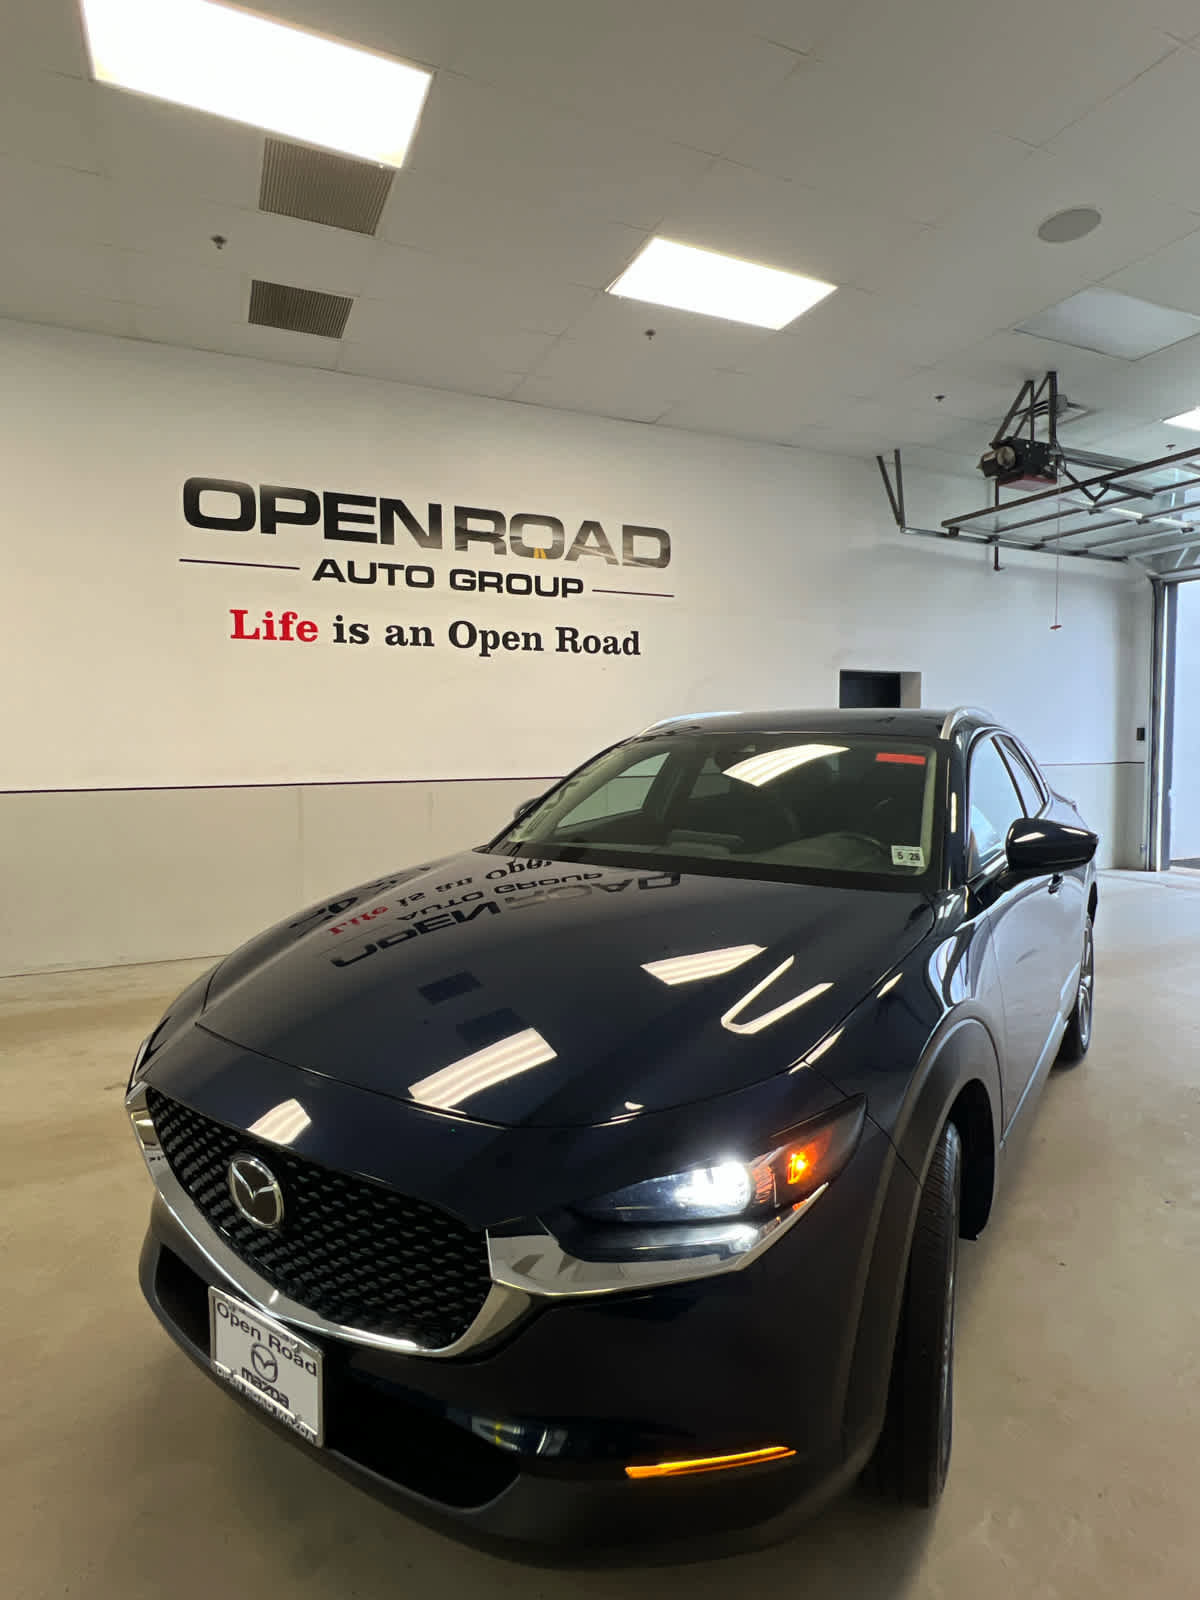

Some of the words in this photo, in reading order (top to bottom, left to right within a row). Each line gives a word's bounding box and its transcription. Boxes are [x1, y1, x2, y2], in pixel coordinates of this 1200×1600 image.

[183, 477, 443, 549] OPEN
[454, 505, 672, 569] ROAD
[312, 558, 435, 589] AUTO
[449, 568, 585, 598] GROUP
[229, 608, 318, 642] Life
[333, 614, 370, 645] is
[384, 624, 434, 648] an
[448, 620, 544, 656] Open
[555, 626, 641, 656] Road
[217, 1302, 262, 1341] Open
[269, 1334, 317, 1377] Road
